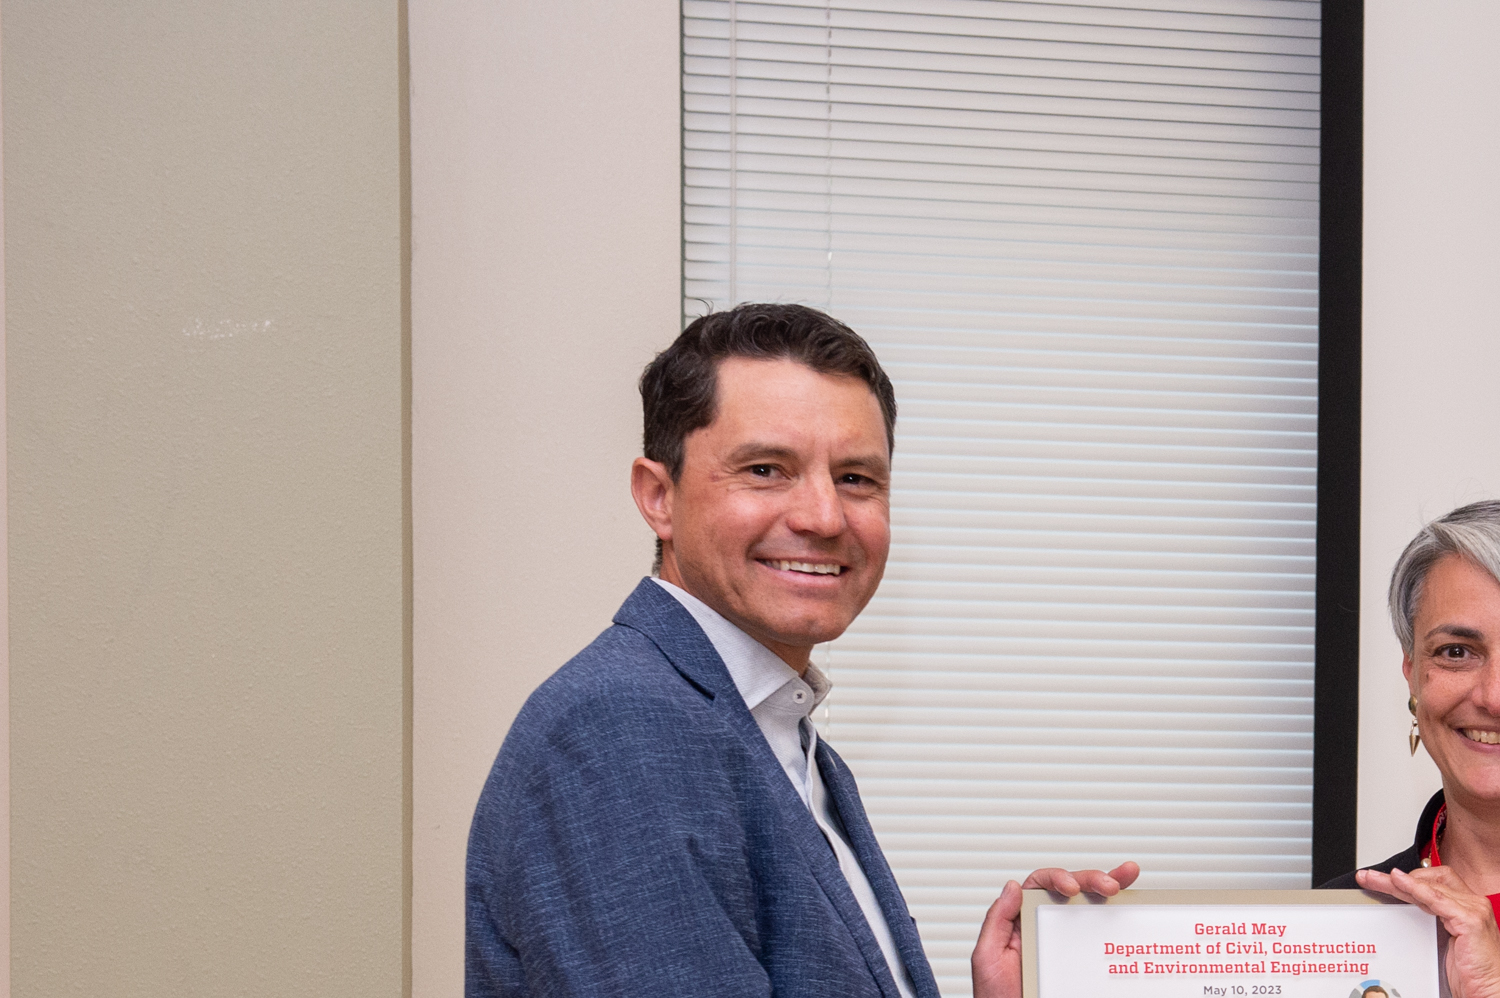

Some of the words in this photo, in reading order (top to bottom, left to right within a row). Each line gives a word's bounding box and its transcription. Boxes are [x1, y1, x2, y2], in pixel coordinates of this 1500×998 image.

[1195, 923, 1246, 935] Gerald
[1252, 923, 1286, 937] May
[1104, 942, 1201, 957] Department
[1206, 942, 1221, 954] of
[1226, 942, 1268, 954] Civil,
[1272, 942, 1376, 954] Construction
[1109, 962, 1138, 974] and
[1144, 961, 1266, 974] Environmental
[1271, 960, 1369, 976] Engineering
[1203, 986, 1227, 997] May
[1232, 985, 1248, 996] 10,
[1252, 986, 1282, 995] 2023
